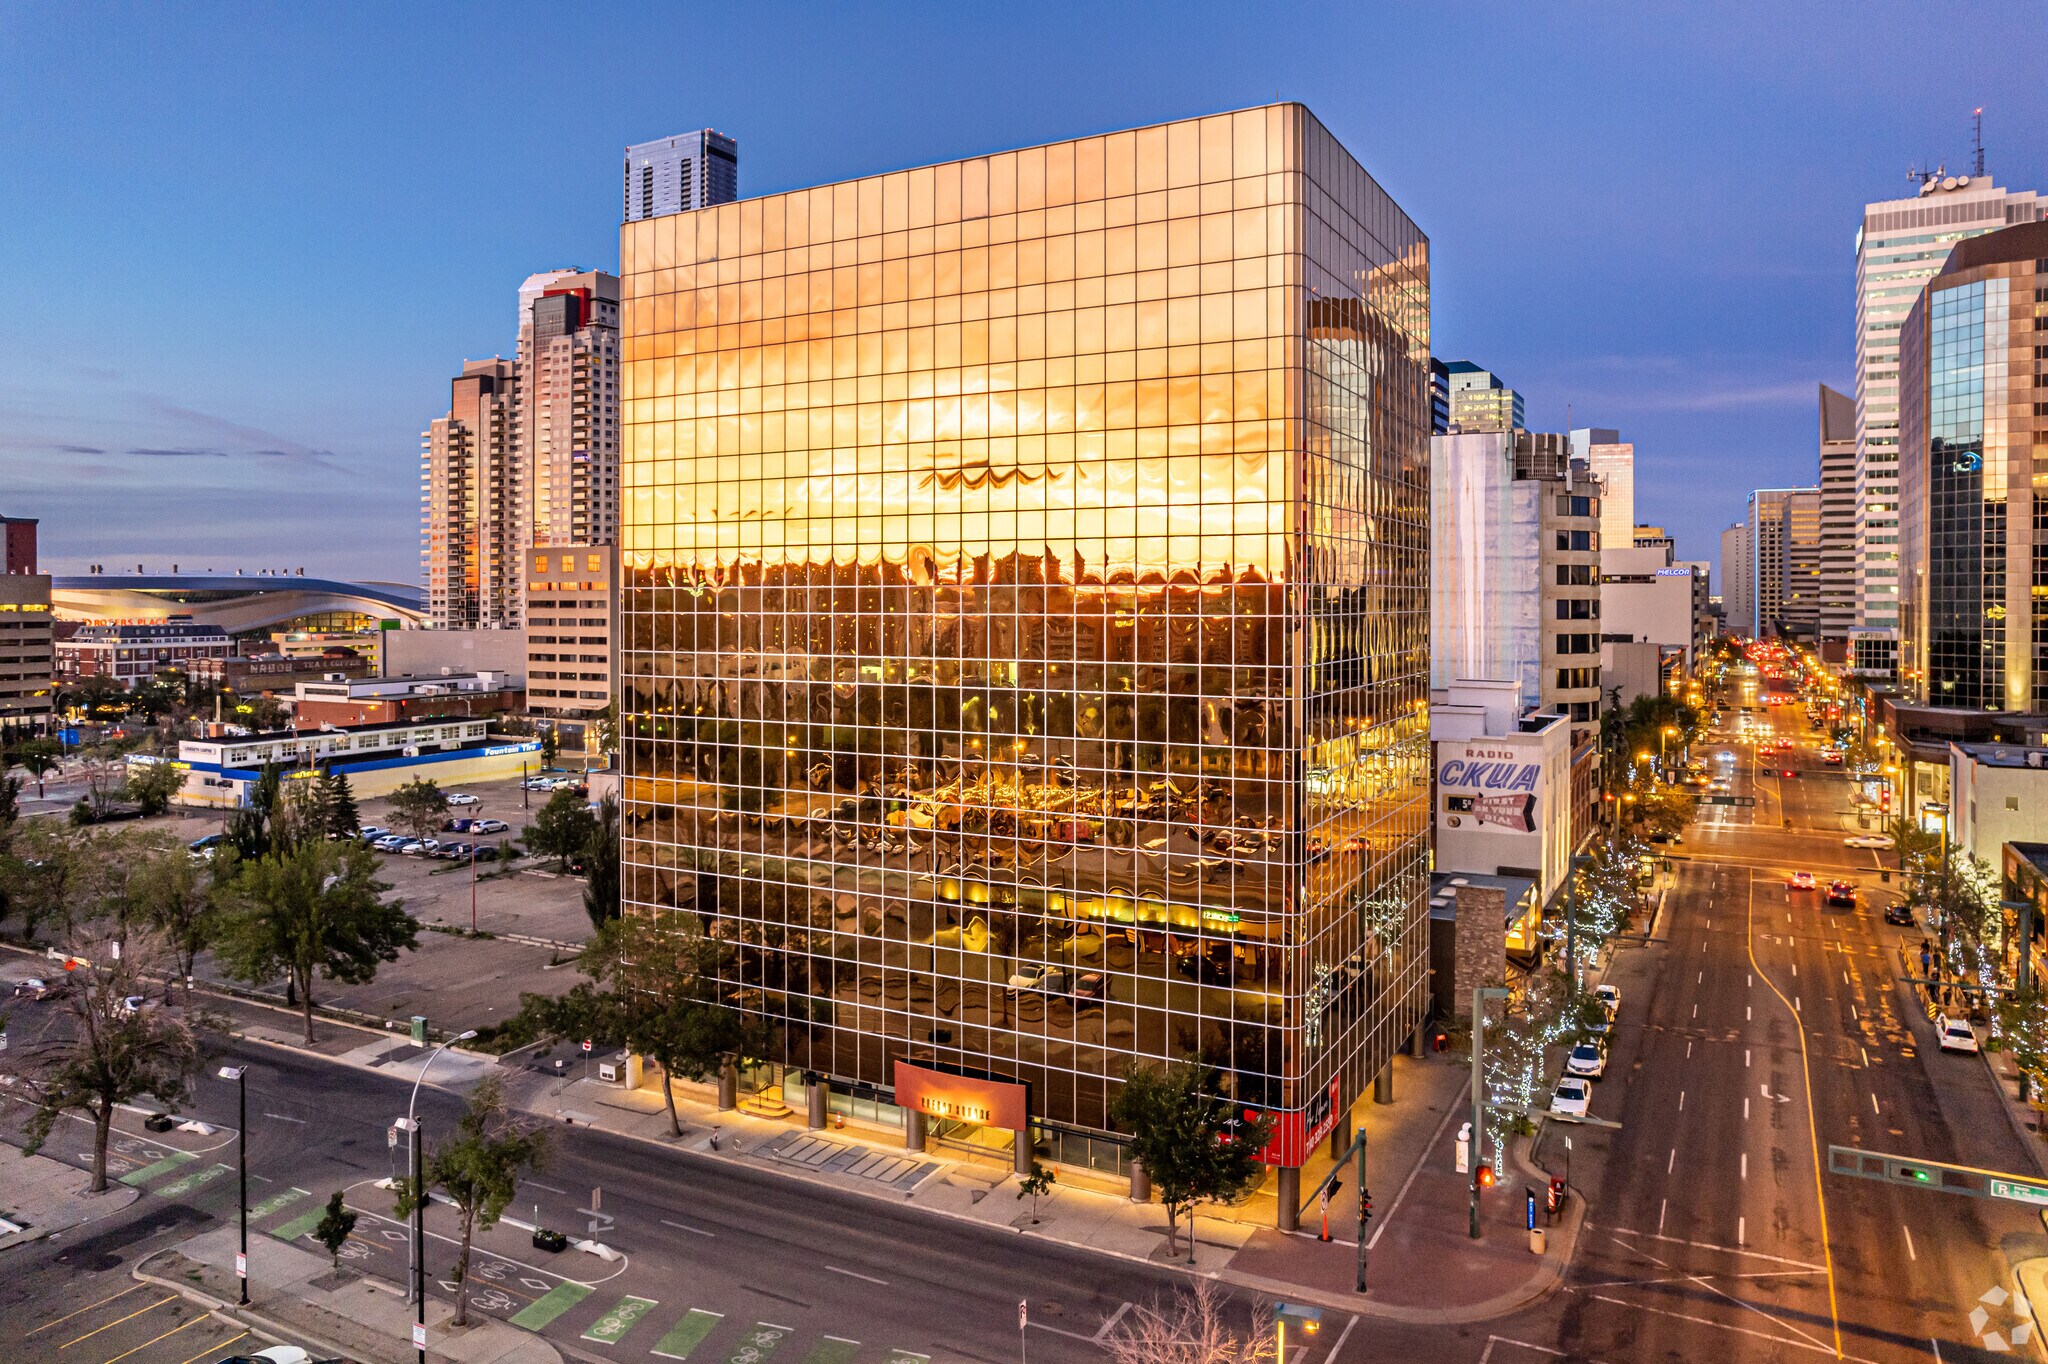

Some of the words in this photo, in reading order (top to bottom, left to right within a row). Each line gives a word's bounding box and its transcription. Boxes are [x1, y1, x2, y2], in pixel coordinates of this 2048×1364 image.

[485, 746, 519, 756] Fountain
[521, 743, 537, 752] Tire
[1466, 749, 1514, 759] RADIO
[1440, 759, 1541, 791] CKUA
[1482, 797, 1515, 805] FIRST
[1474, 805, 1489, 813] ON
[1491, 805, 1521, 815] YOUR
[1484, 813, 1513, 825] DIAL
